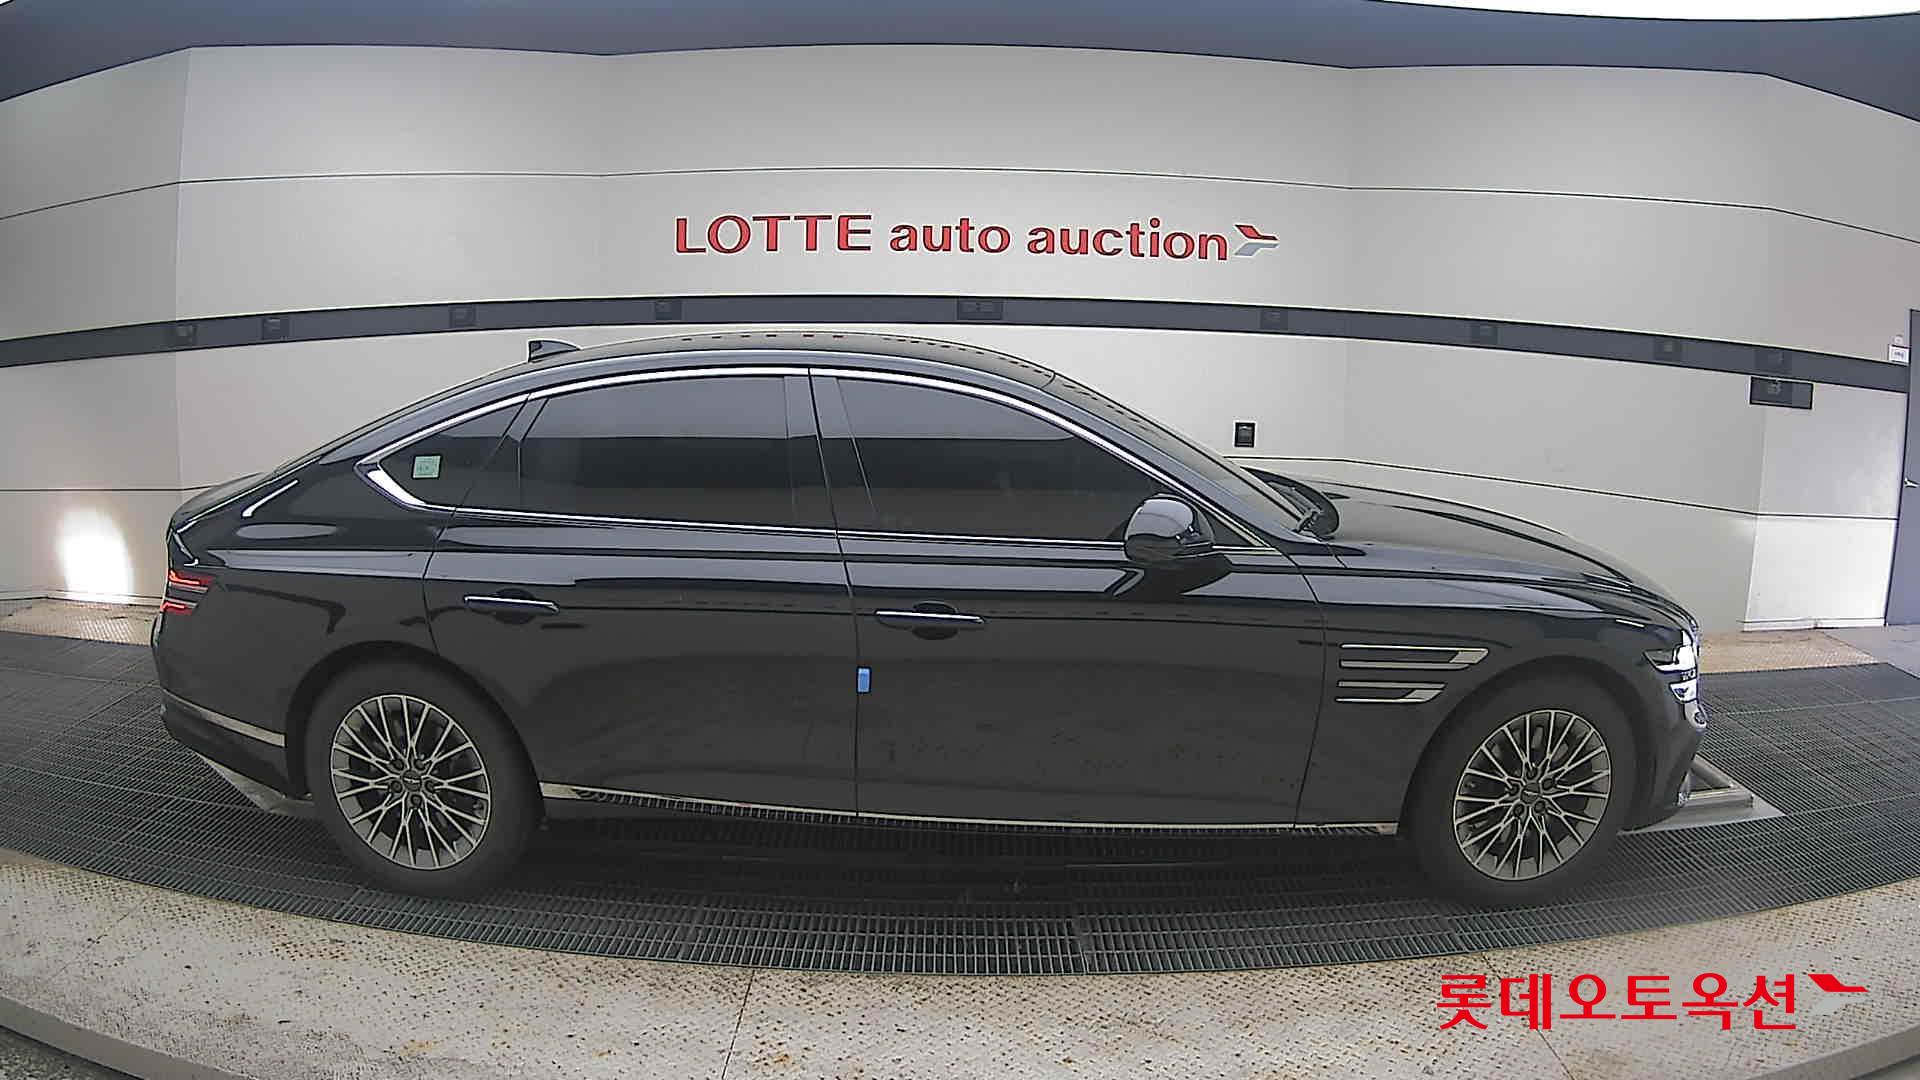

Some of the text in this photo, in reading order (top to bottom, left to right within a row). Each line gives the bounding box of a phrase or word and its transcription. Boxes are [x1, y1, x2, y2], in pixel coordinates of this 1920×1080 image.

[675, 215, 1229, 261] LOTTE auto auction
